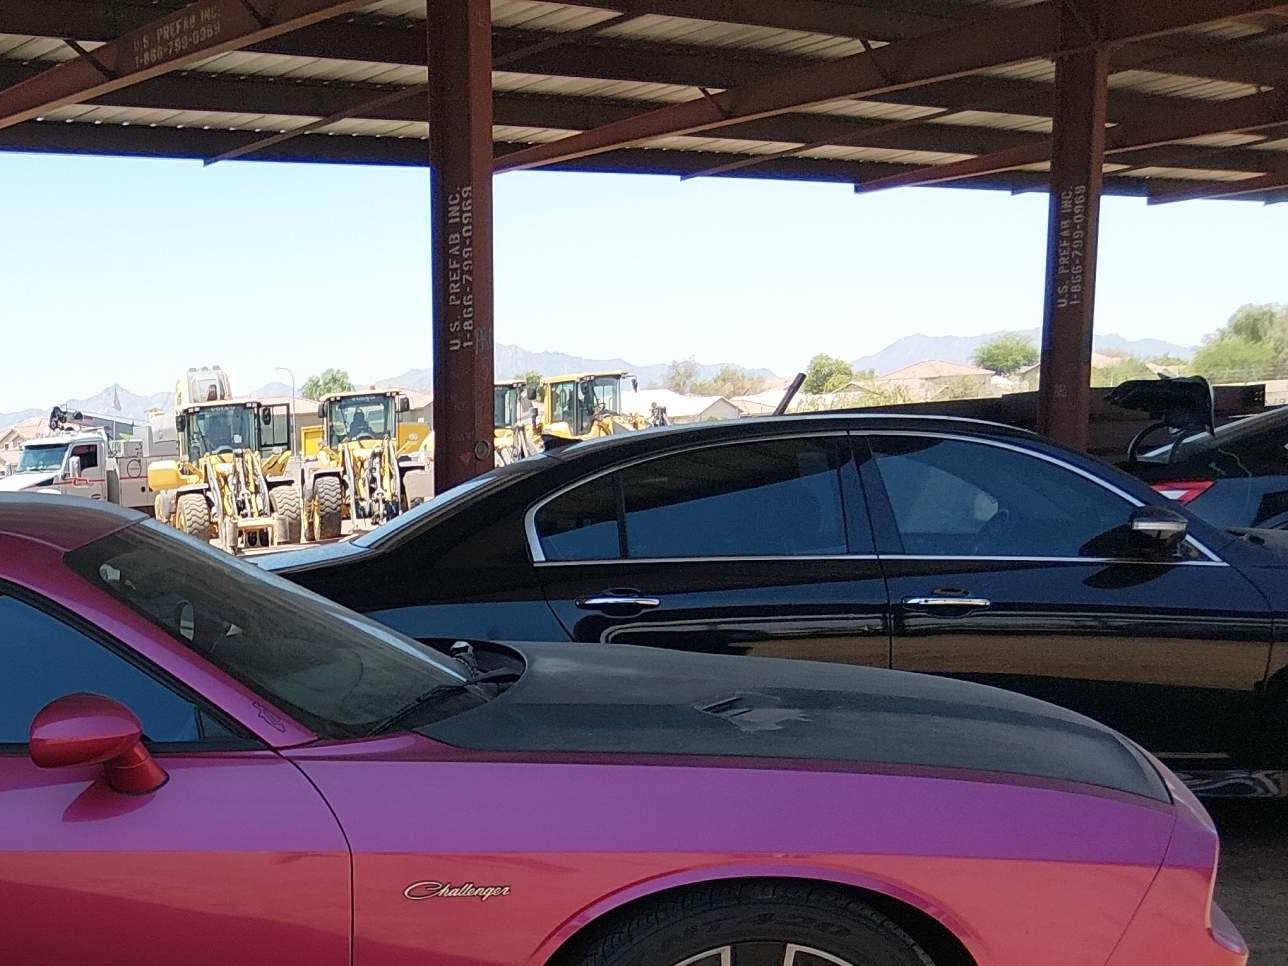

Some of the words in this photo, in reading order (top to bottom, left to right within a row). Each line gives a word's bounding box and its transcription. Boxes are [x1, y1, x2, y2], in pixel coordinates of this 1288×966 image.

[448, 186, 461, 223] INC.
[448, 233, 461, 306] PREFAB
[462, 185, 473, 348] 1-866-799-0969
[403, 880, 511, 902] Challenger
